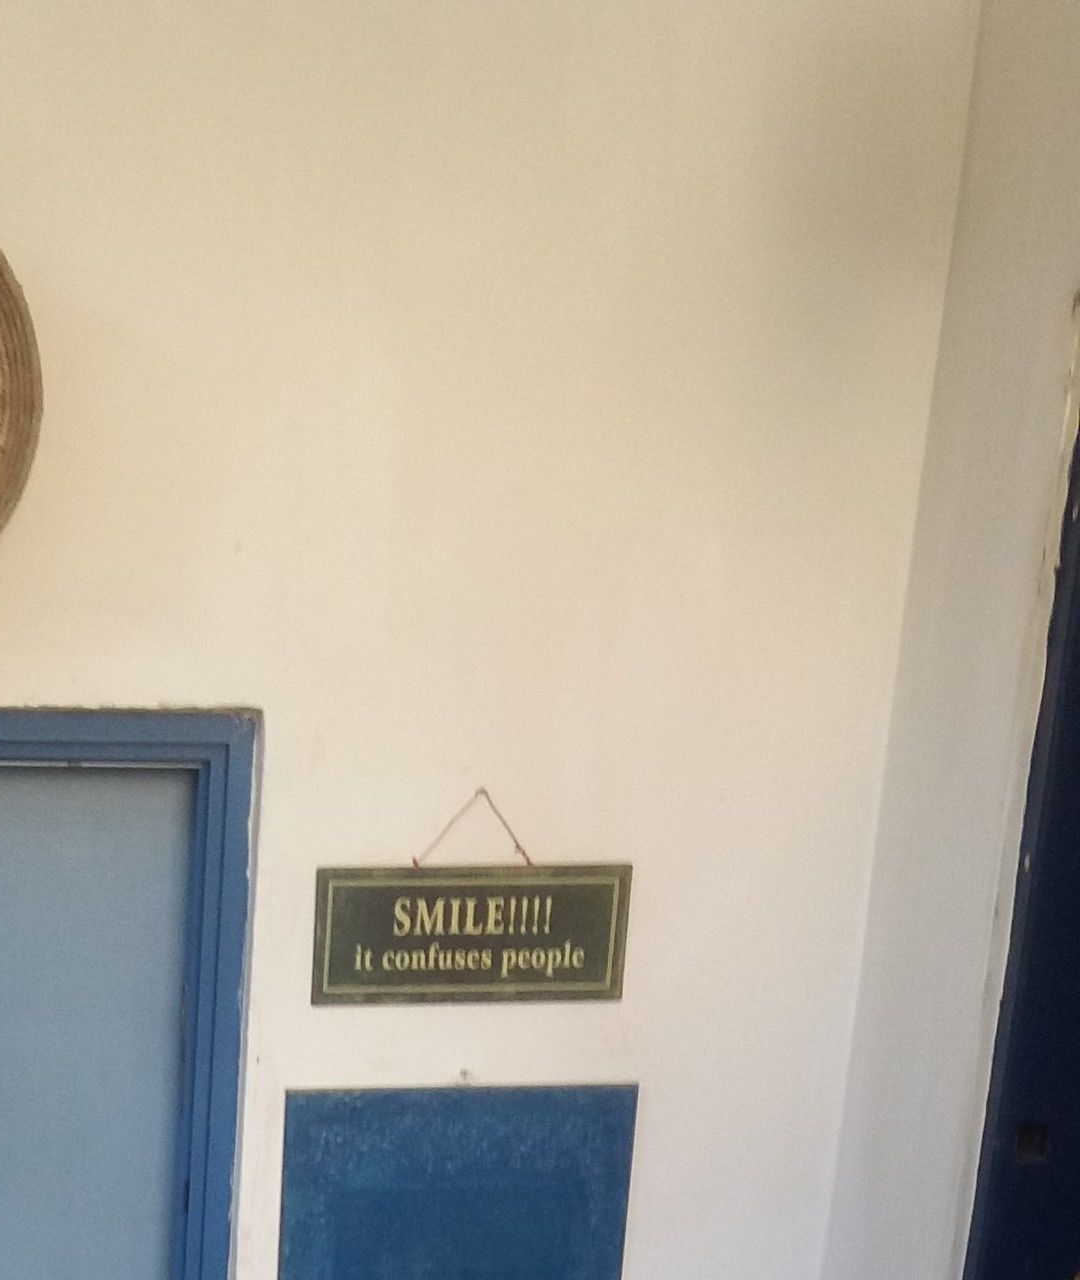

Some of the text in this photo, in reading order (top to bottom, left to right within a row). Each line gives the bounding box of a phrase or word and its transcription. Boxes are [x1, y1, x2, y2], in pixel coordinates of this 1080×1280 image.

[393, 895, 553, 937] SMILE!!!!
[354, 939, 586, 978] it confuses people
